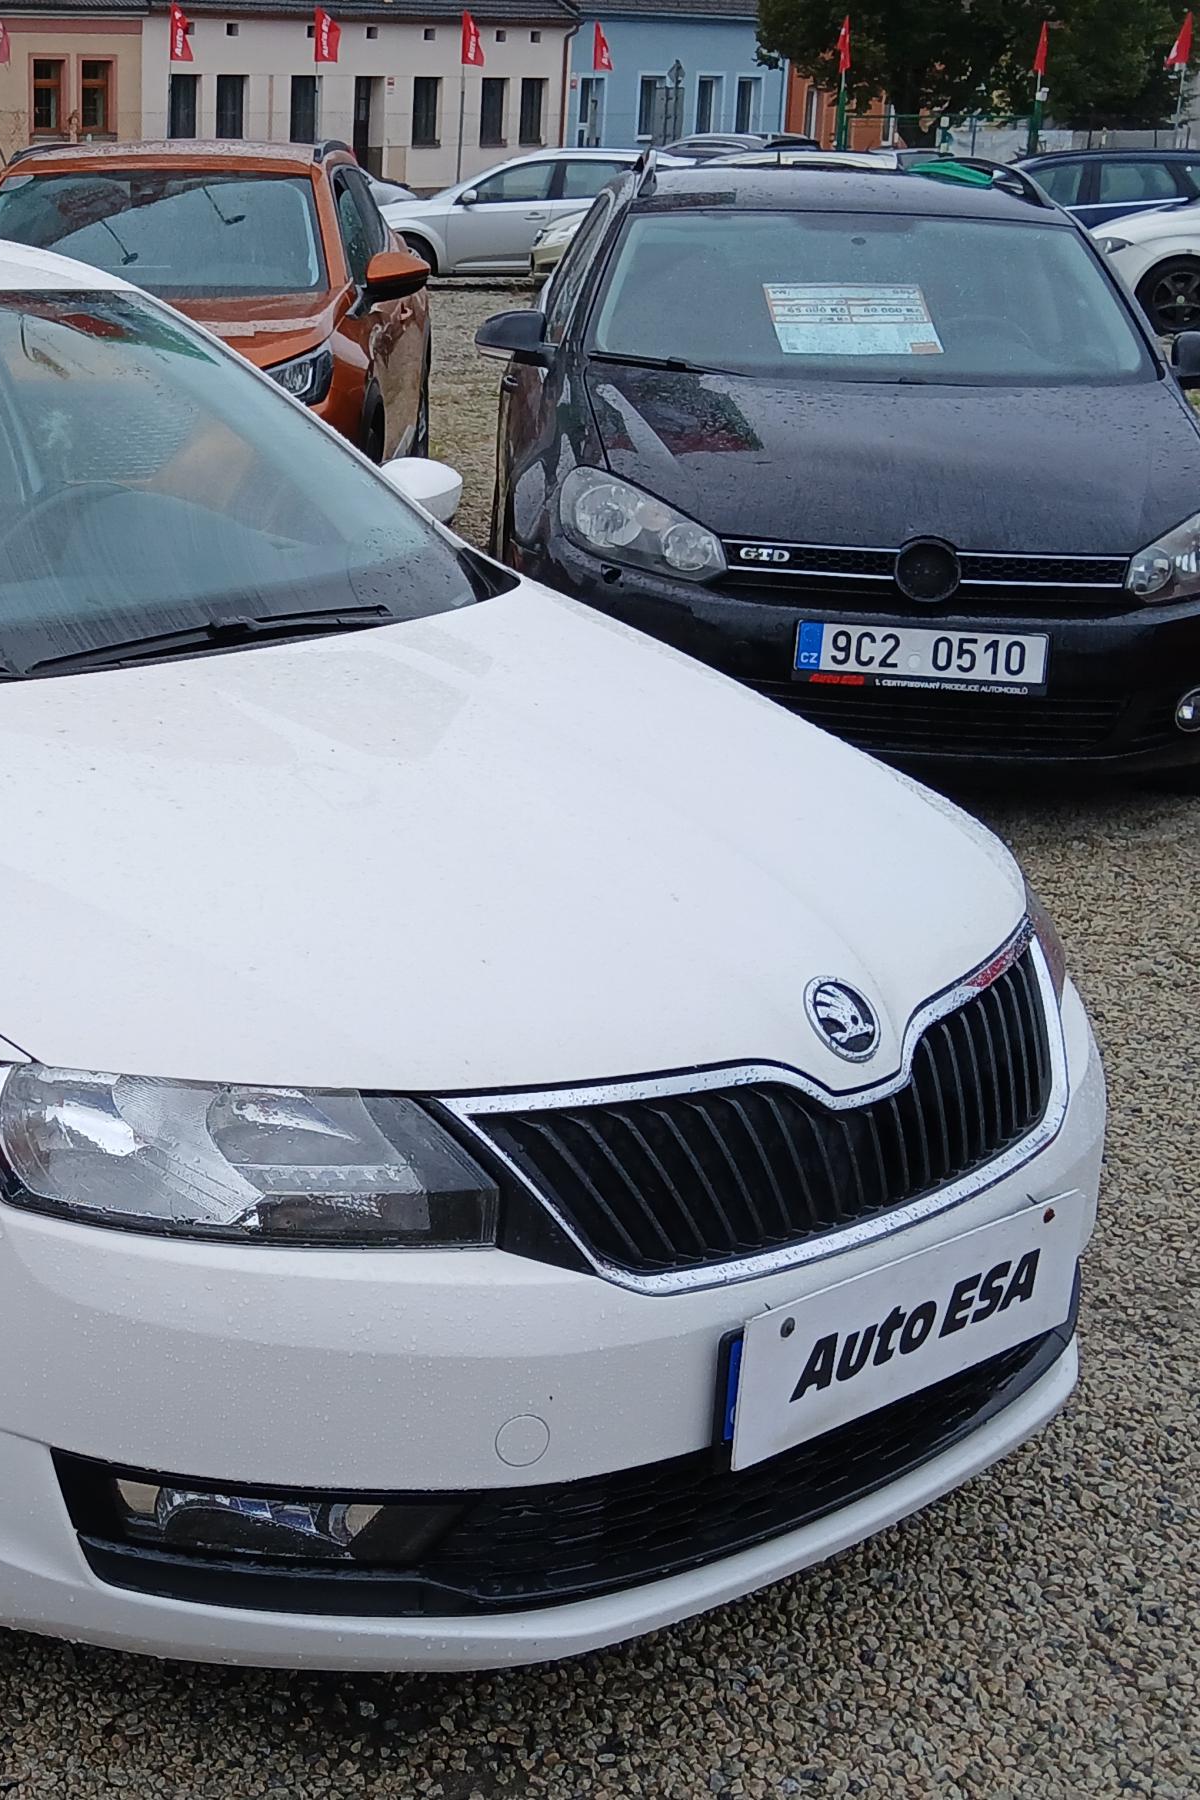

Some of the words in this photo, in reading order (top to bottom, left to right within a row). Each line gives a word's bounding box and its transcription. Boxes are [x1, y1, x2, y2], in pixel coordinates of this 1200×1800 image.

[174, 27, 184, 57] Auto
[740, 547, 790, 562] GTD
[800, 652, 818, 663] CZ
[830, 629, 900, 668] 9C2
[931, 636, 1027, 676] 0510
[789, 1301, 937, 1403] Auto
[939, 1248, 1041, 1339] ESA
